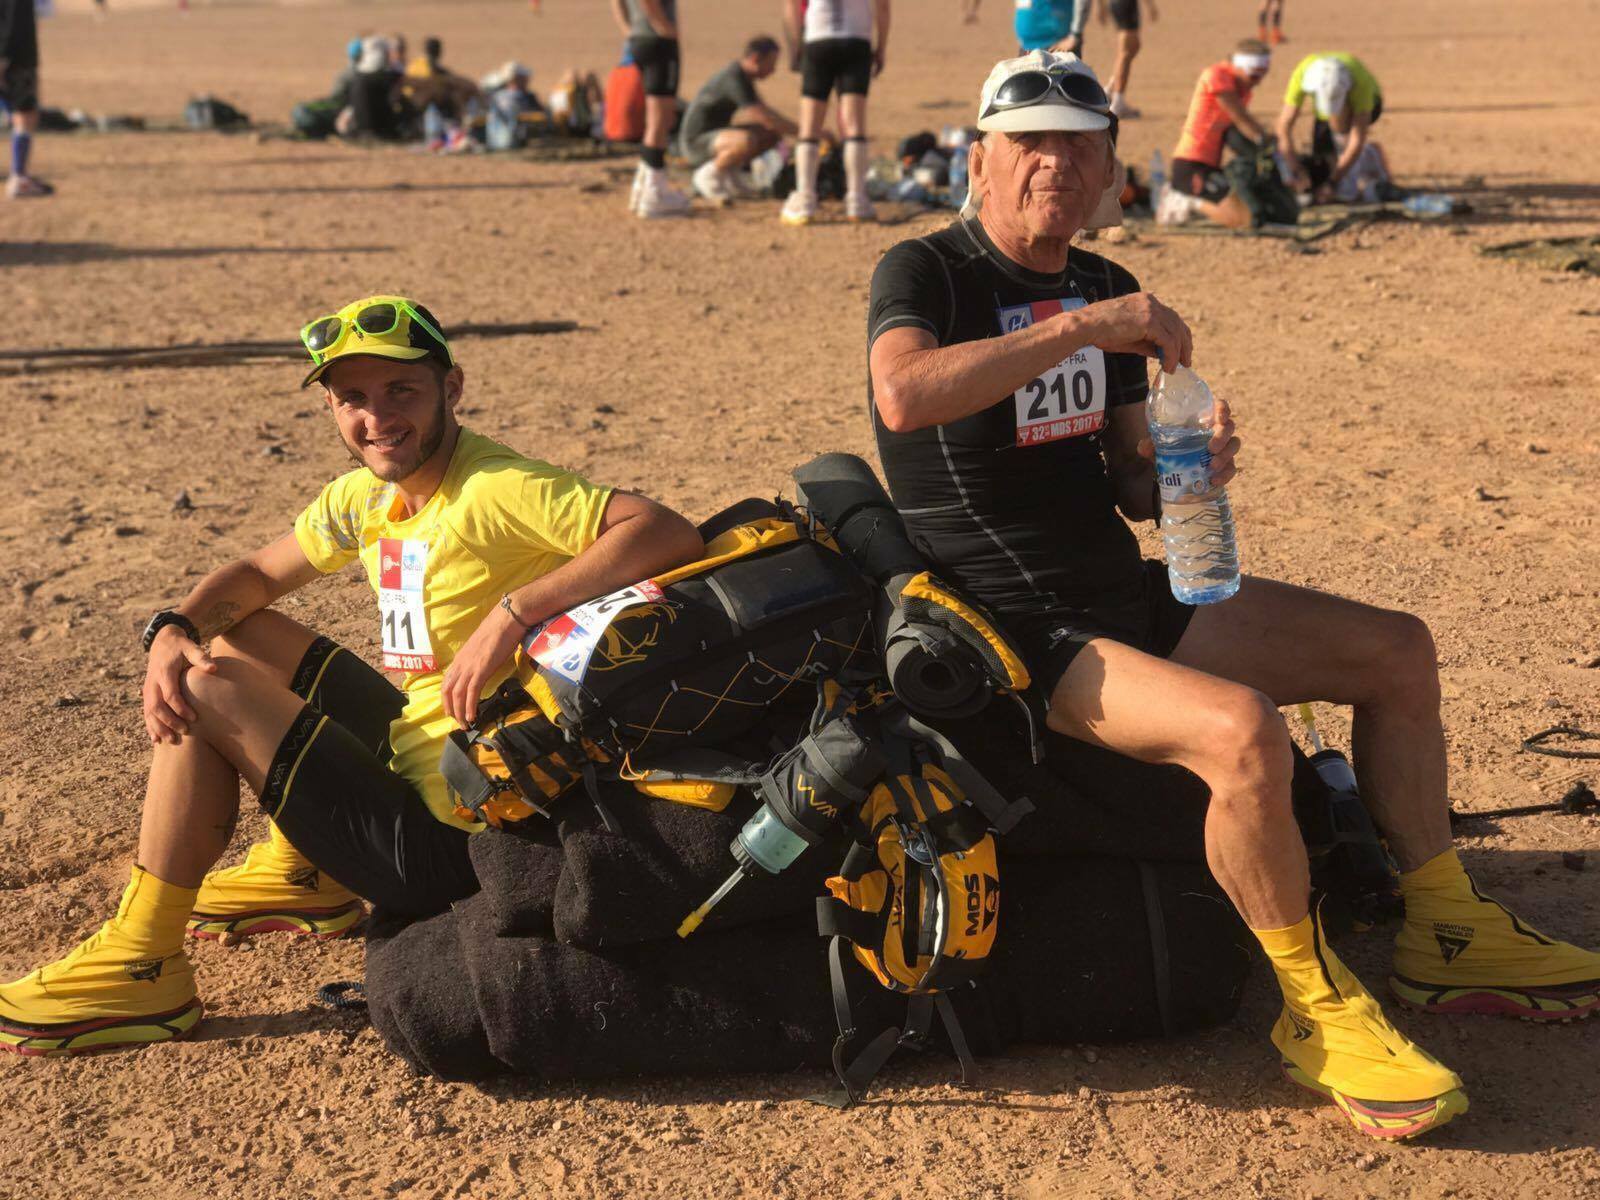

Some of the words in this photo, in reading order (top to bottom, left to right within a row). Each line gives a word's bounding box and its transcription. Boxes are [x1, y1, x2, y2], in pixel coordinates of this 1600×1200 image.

[1069, 353, 1088, 366] FRA
[1025, 369, 1093, 421] 210
[1050, 420, 1072, 437] MDS
[1073, 415, 1093, 432] 2017
[964, 873, 981, 937] MDS
